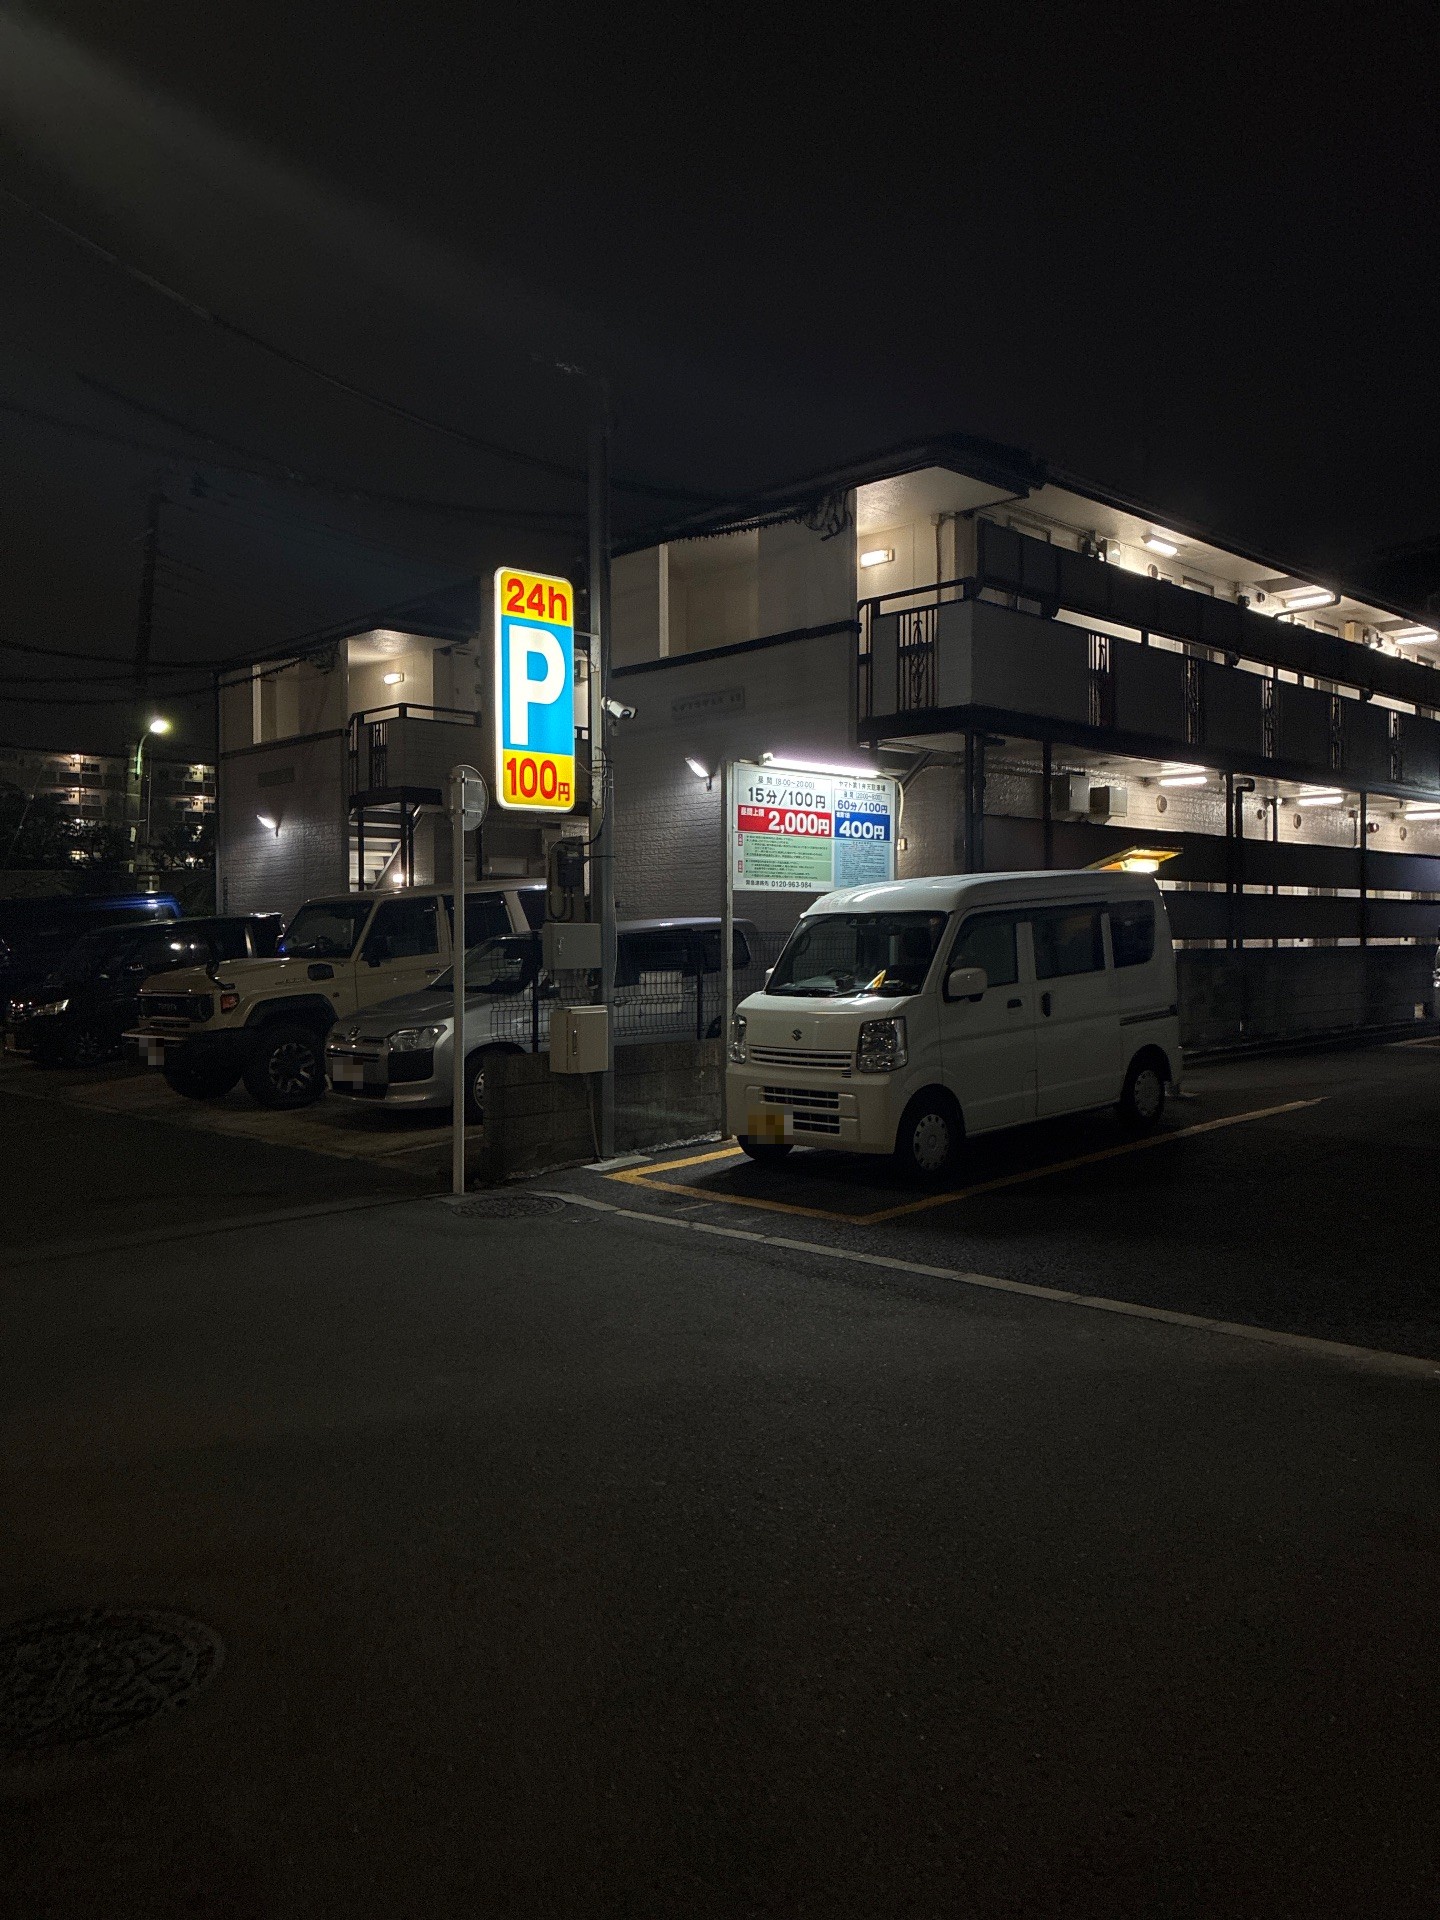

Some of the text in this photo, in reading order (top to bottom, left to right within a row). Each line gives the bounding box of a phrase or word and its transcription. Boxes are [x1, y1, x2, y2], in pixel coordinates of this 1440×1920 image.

[506, 578, 568, 621] 24h
[508, 624, 566, 746] P
[506, 757, 570, 802] 100円
[768, 811, 830, 835] 2,000円
[839, 820, 885, 839] 400円
